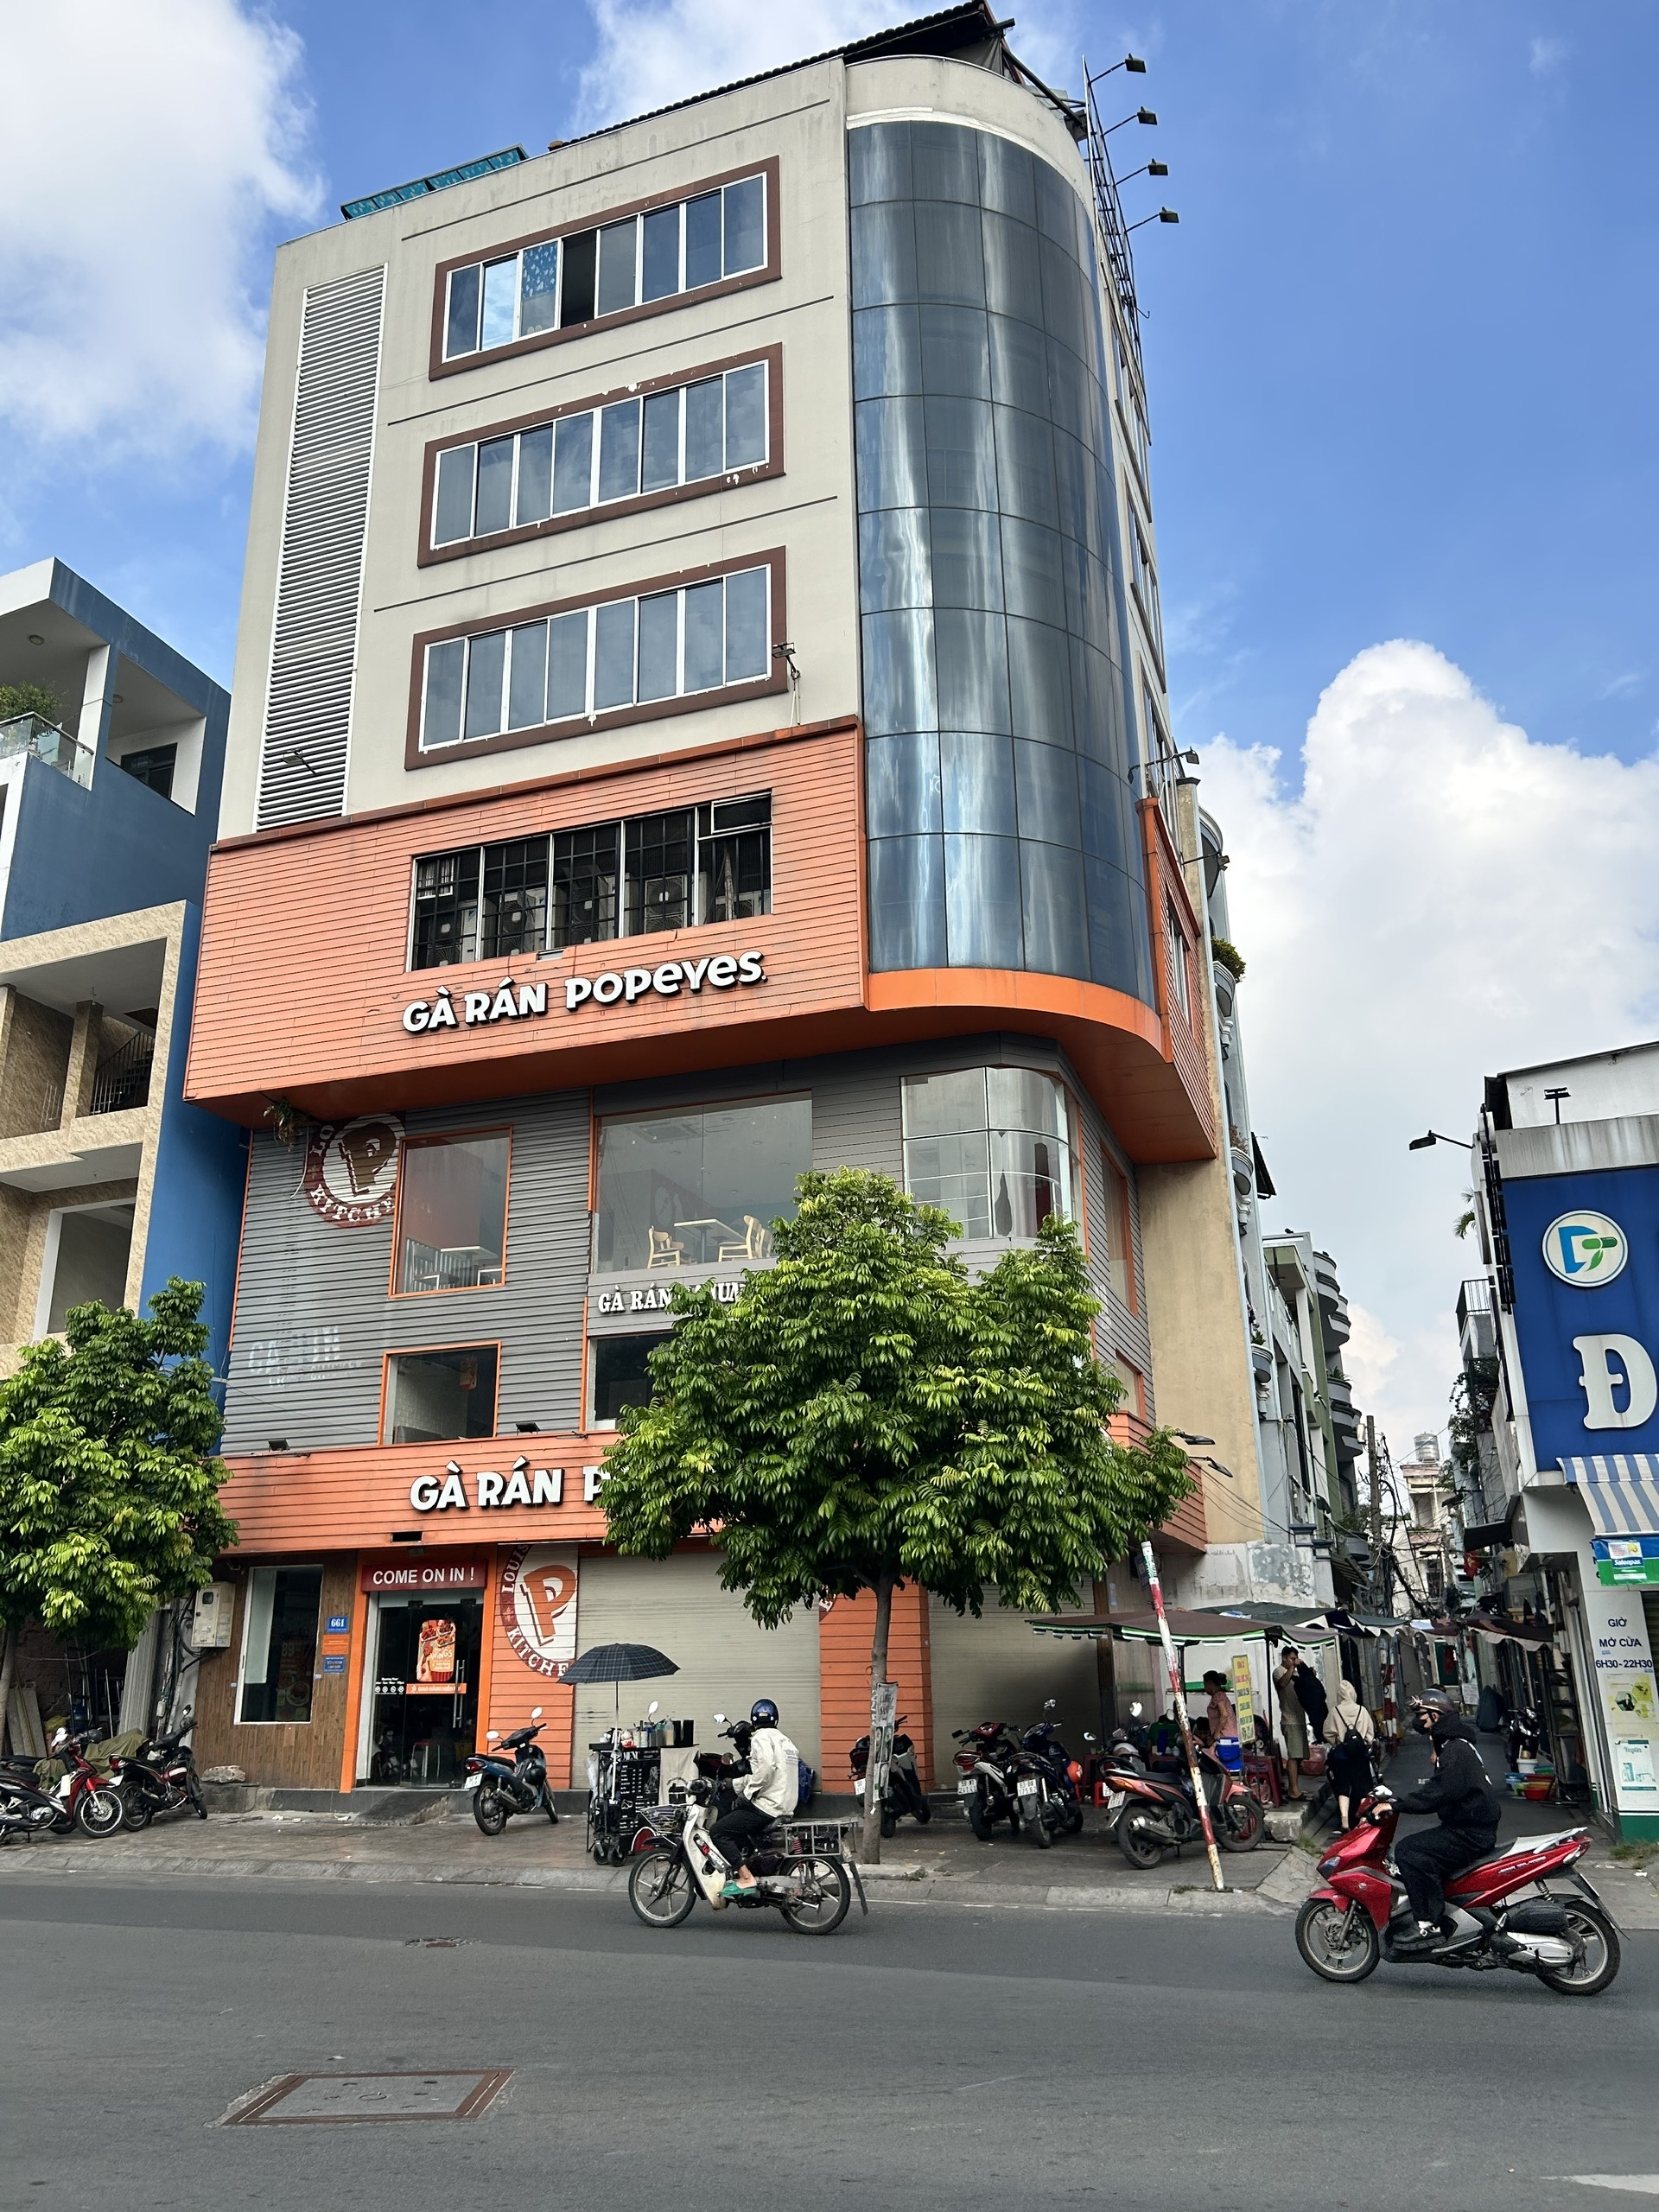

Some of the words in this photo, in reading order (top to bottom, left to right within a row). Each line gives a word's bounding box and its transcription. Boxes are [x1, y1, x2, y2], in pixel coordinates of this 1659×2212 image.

[402, 985, 459, 1033] GÀ
[464, 976, 549, 1024] RÁN
[598, 1285, 626, 1313] GÀ
[630, 1282, 679, 1311] RÁN
[1573, 1333, 1658, 1430] Đ
[410, 1460, 469, 1510] GÀ
[477, 1455, 564, 1506] RÁN
[372, 1569, 418, 1585] COME
[422, 1568, 445, 1583] ON
[449, 1567, 465, 1582] IN
[470, 1567, 474, 1581] !
[331, 1618, 345, 1628] 661
[1595, 1659, 1618, 1669] 6H30
[1623, 1659, 1653, 1669] 22H30
